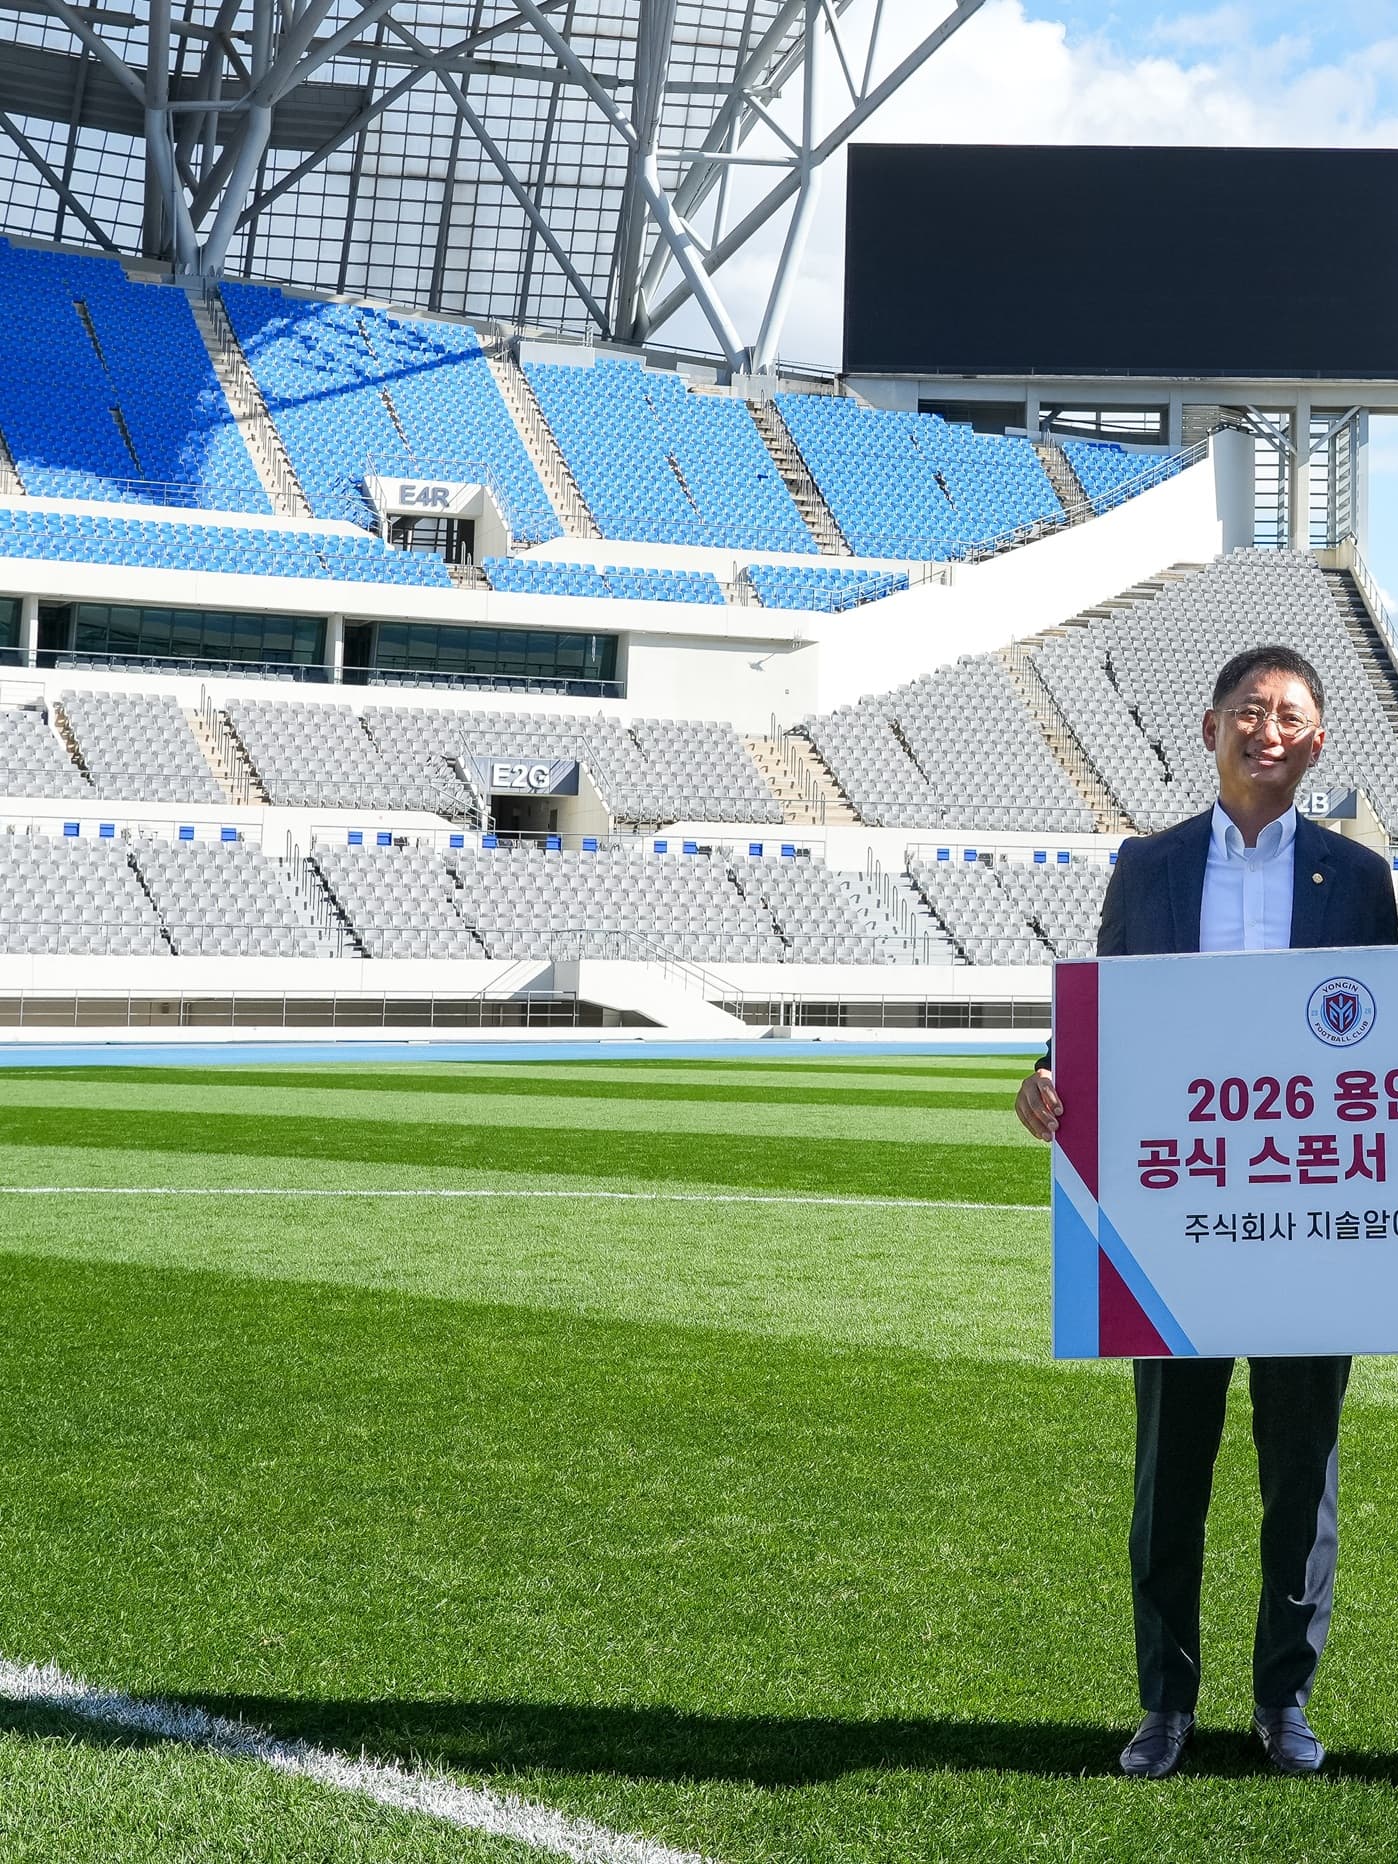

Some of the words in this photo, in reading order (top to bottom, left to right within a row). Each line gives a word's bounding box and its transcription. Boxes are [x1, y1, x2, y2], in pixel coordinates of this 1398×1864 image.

[400, 484, 450, 508] E4R
[493, 763, 550, 788] E2G
[1322, 982, 1359, 993] YONGIN
[1315, 1022, 1351, 1042] FOOTBALL
[1352, 1020, 1369, 1038] CLUB
[1188, 1076, 1314, 1121] 2026
[1138, 1138, 1226, 1189] 공식
[1248, 1133, 1386, 1184] 스폰서
[1185, 1211, 1296, 1243] 주식회사
